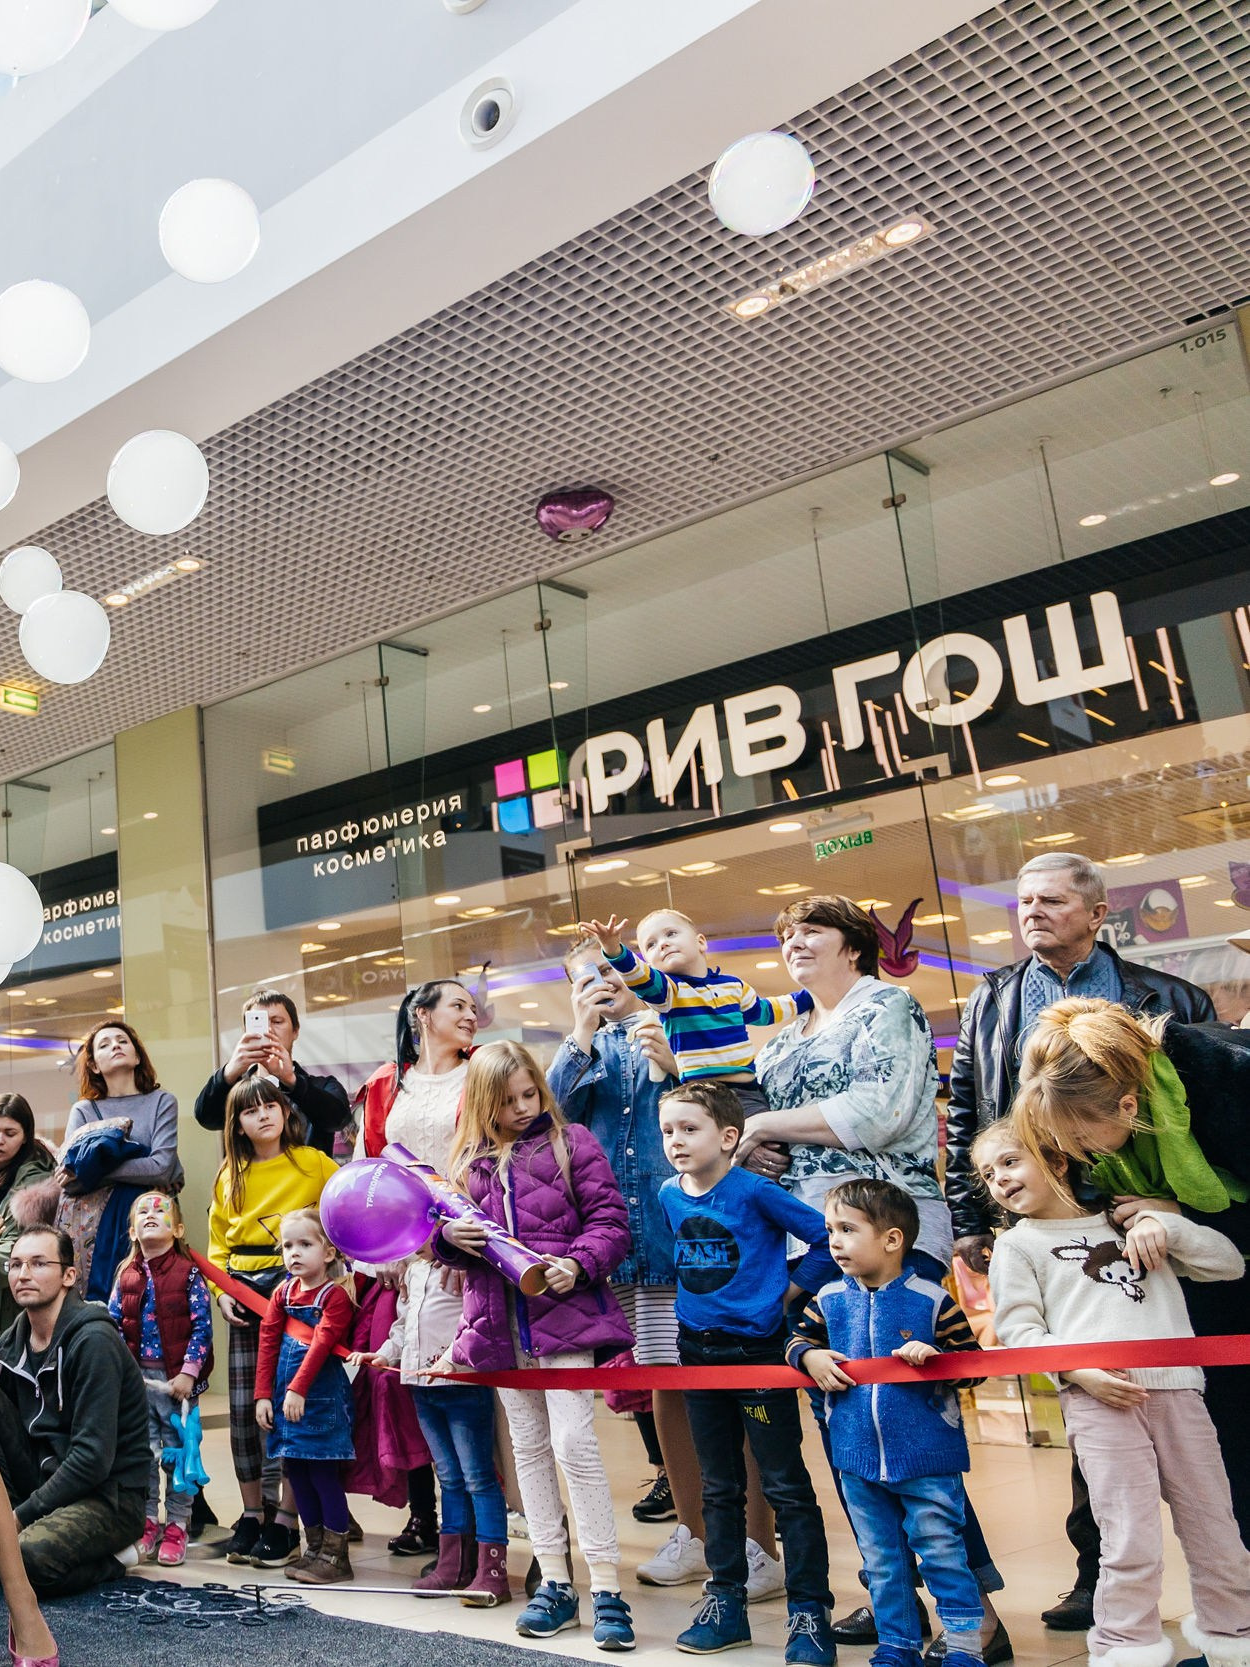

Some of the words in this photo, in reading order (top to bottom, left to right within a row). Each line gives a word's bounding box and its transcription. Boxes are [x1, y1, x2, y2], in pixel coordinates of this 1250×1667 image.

[1179, 328, 1227, 353] 1.015
[585, 684, 807, 815] РИВ
[832, 590, 1132, 751] ГОШ
[296, 794, 462, 853] парфюмерия
[43, 889, 121, 922] арфюме
